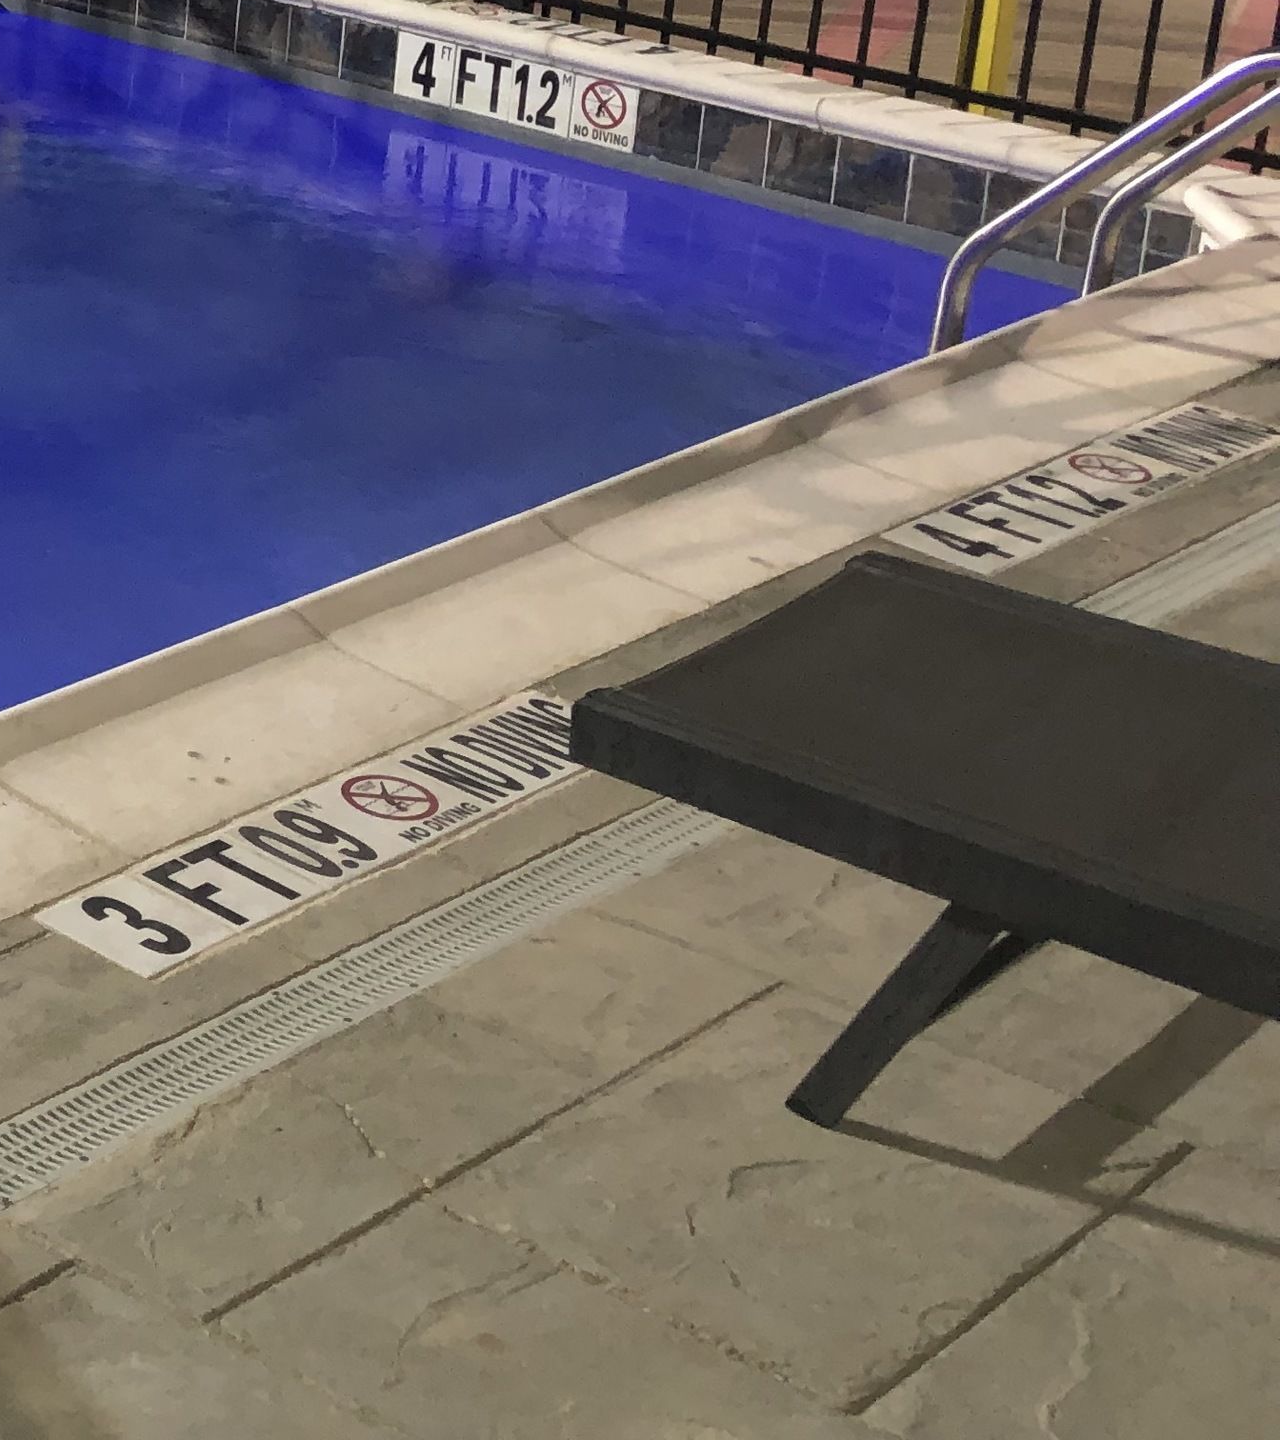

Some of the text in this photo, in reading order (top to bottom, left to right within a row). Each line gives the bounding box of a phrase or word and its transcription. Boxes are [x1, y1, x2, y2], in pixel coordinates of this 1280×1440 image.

[411, 42, 436, 98] 4
[456, 47, 512, 113] FT
[514, 64, 560, 130] 1.2
[573, 123, 629, 147] NO DIVING
[399, 747, 525, 804] NO
[398, 802, 482, 843] NO DIVING
[81, 896, 191, 956] 3
[142, 839, 302, 926] FT
